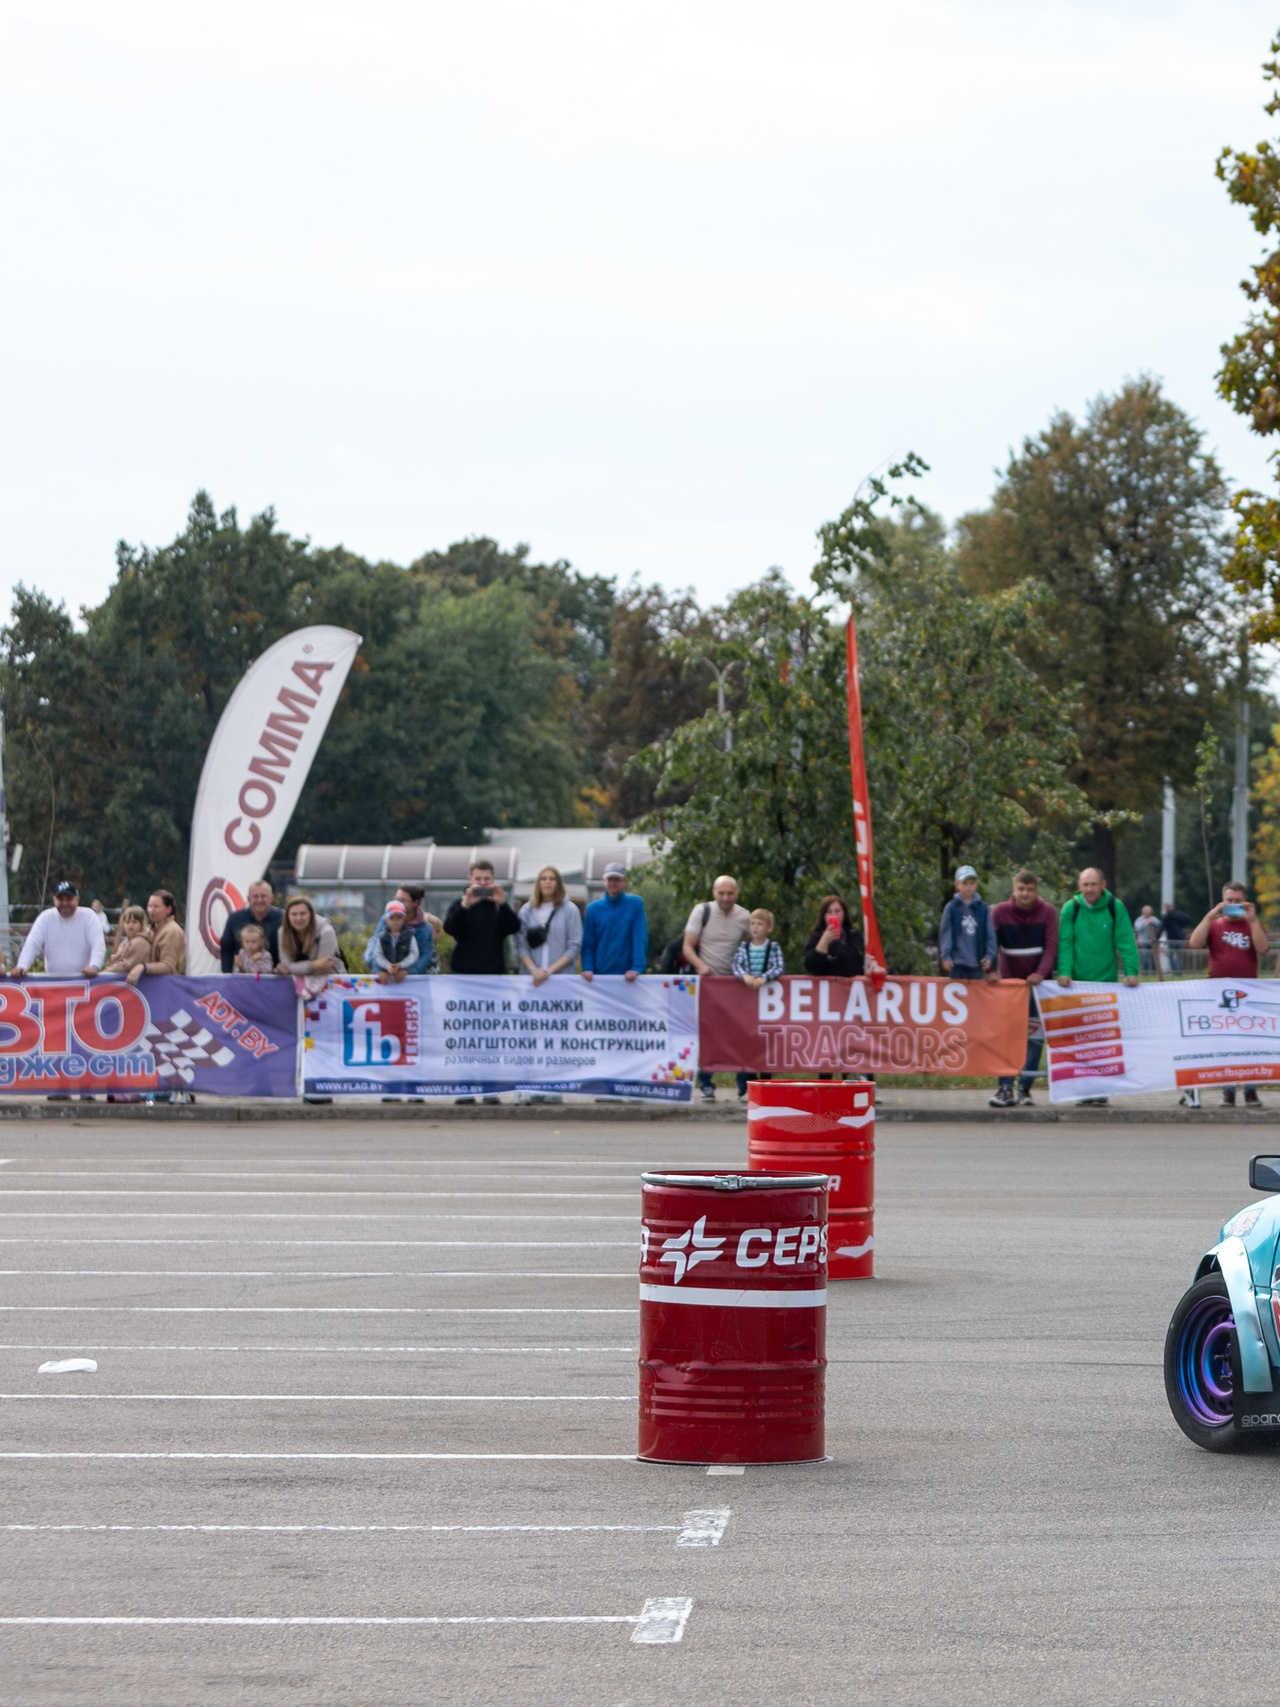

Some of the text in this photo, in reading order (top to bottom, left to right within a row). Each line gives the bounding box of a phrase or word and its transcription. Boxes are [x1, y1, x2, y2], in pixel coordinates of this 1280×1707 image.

[225, 661, 334, 855] COMMA
[446, 1000, 584, 1012] ФЛАГИ И ФЛАЖКИ
[758, 980, 969, 1025] BELARUS
[195, 991, 279, 1058] ADT.BY
[443, 1018, 667, 1032] КОРПОРАТИВНАЯ СИМВОЛИКА
[1187, 1014, 1278, 1032] FBSPORT
[445, 1037, 666, 1052] ФЛАГШТОКИ И КОНСТРУКЦИИ
[758, 1024, 968, 1070] TRACTORS
[444, 1055, 596, 1067] различных видов и размеров
[1198, 1066, 1273, 1079] www.fbsport.by
[316, 1082, 383, 1091] WWW.FLAG.BY
[416, 1085, 483, 1094] WWW.FLAG.BY
[613, 1083, 681, 1097] WWW.FLAG.BY
